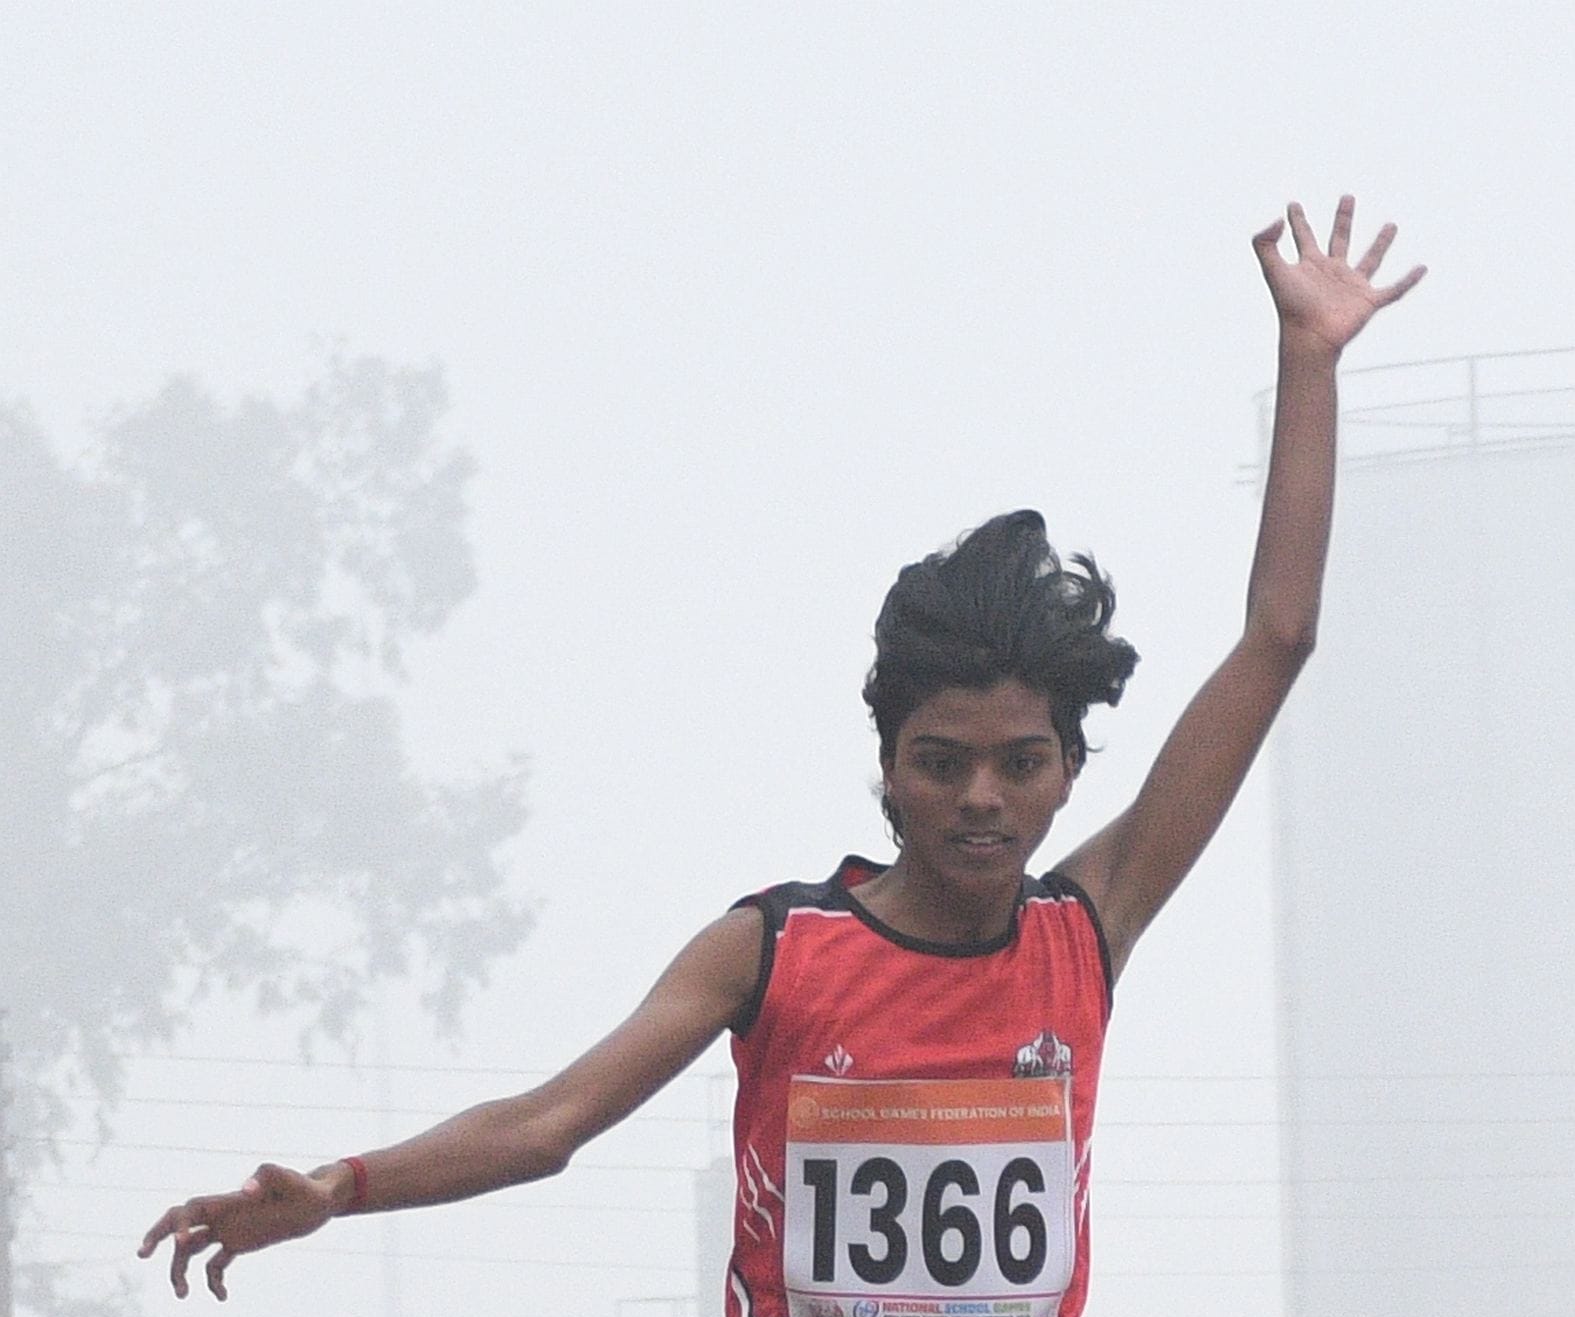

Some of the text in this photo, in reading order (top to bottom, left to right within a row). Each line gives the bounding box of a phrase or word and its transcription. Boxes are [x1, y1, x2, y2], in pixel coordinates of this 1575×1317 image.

[820, 1103, 1061, 1120] SCHOOL GAMES FEDERATION OF INDIA
[803, 1156, 1047, 1287] 1366
[882, 1302, 942, 1314] NATIONAL
[944, 1303, 991, 1314] SCHOOL
